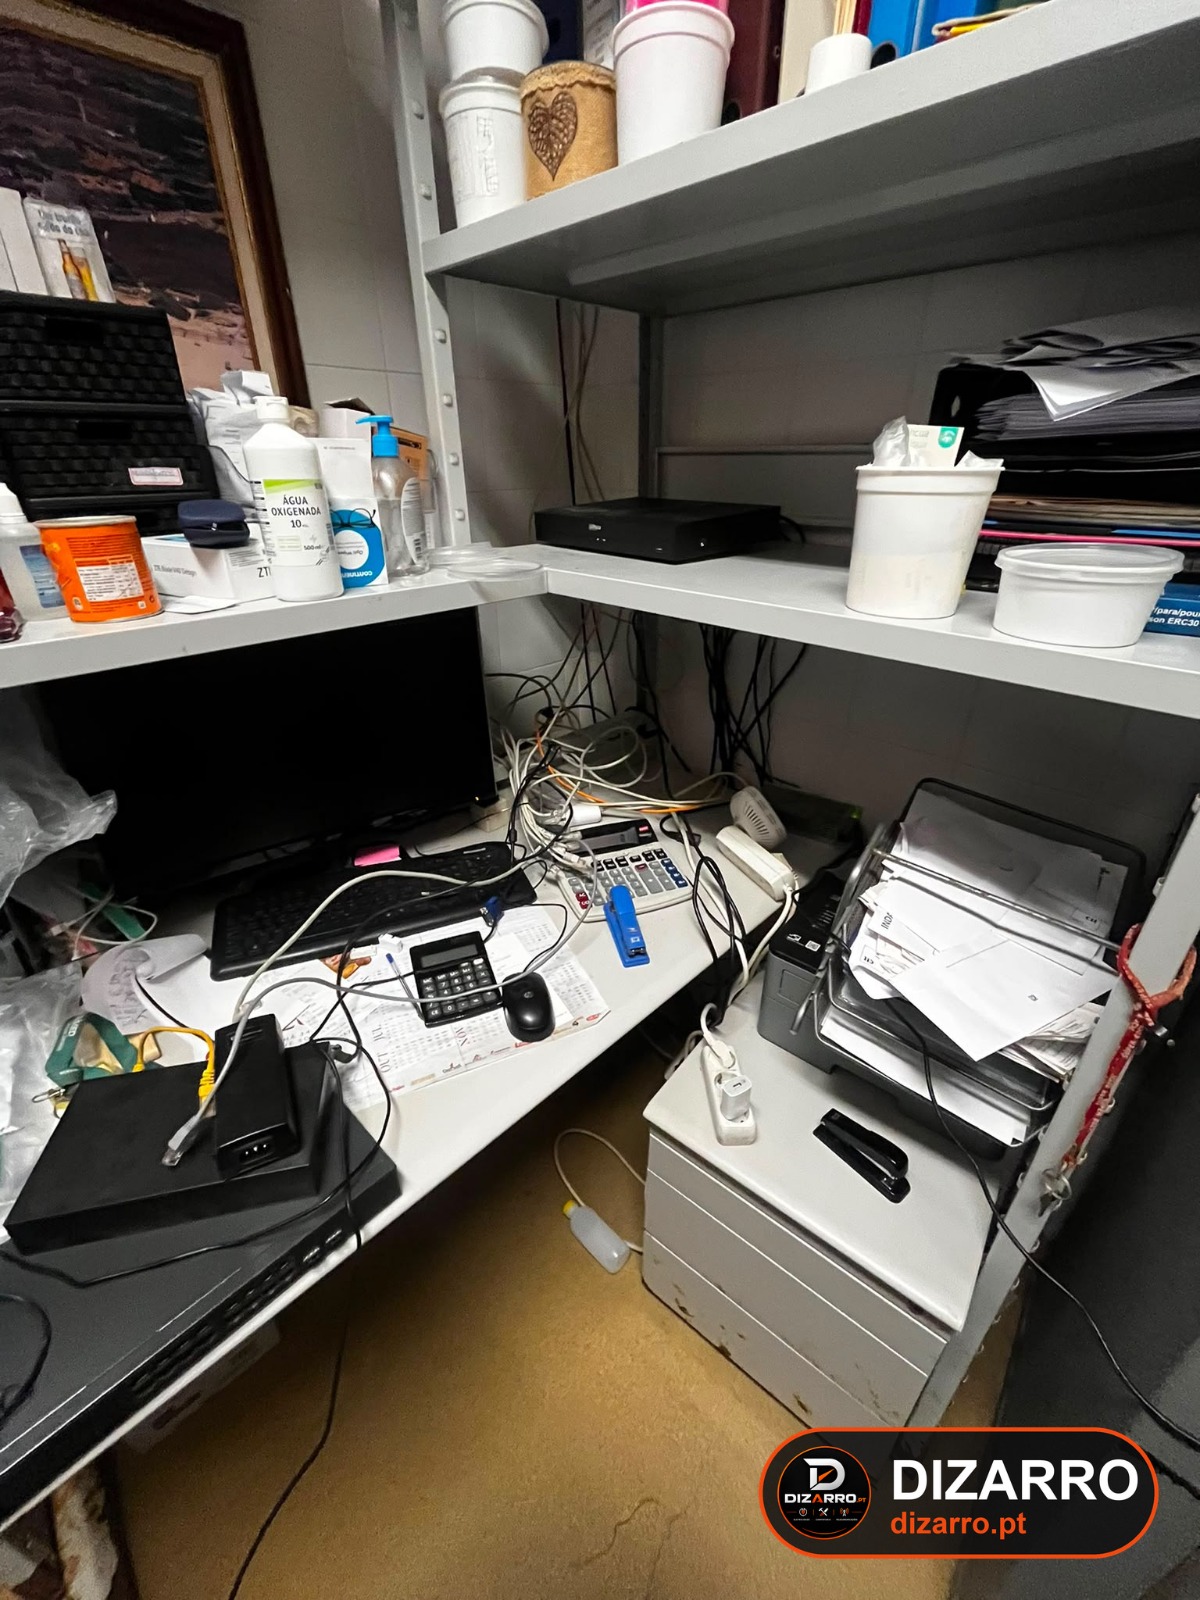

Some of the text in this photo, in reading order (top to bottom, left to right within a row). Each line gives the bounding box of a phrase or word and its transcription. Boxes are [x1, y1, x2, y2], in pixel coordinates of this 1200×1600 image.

[283, 494, 308, 505] ÁGUA
[271, 507, 321, 516] OXIGENADA
[291, 519, 302, 528] 10
[1167, 617, 1200, 627] ERC30
